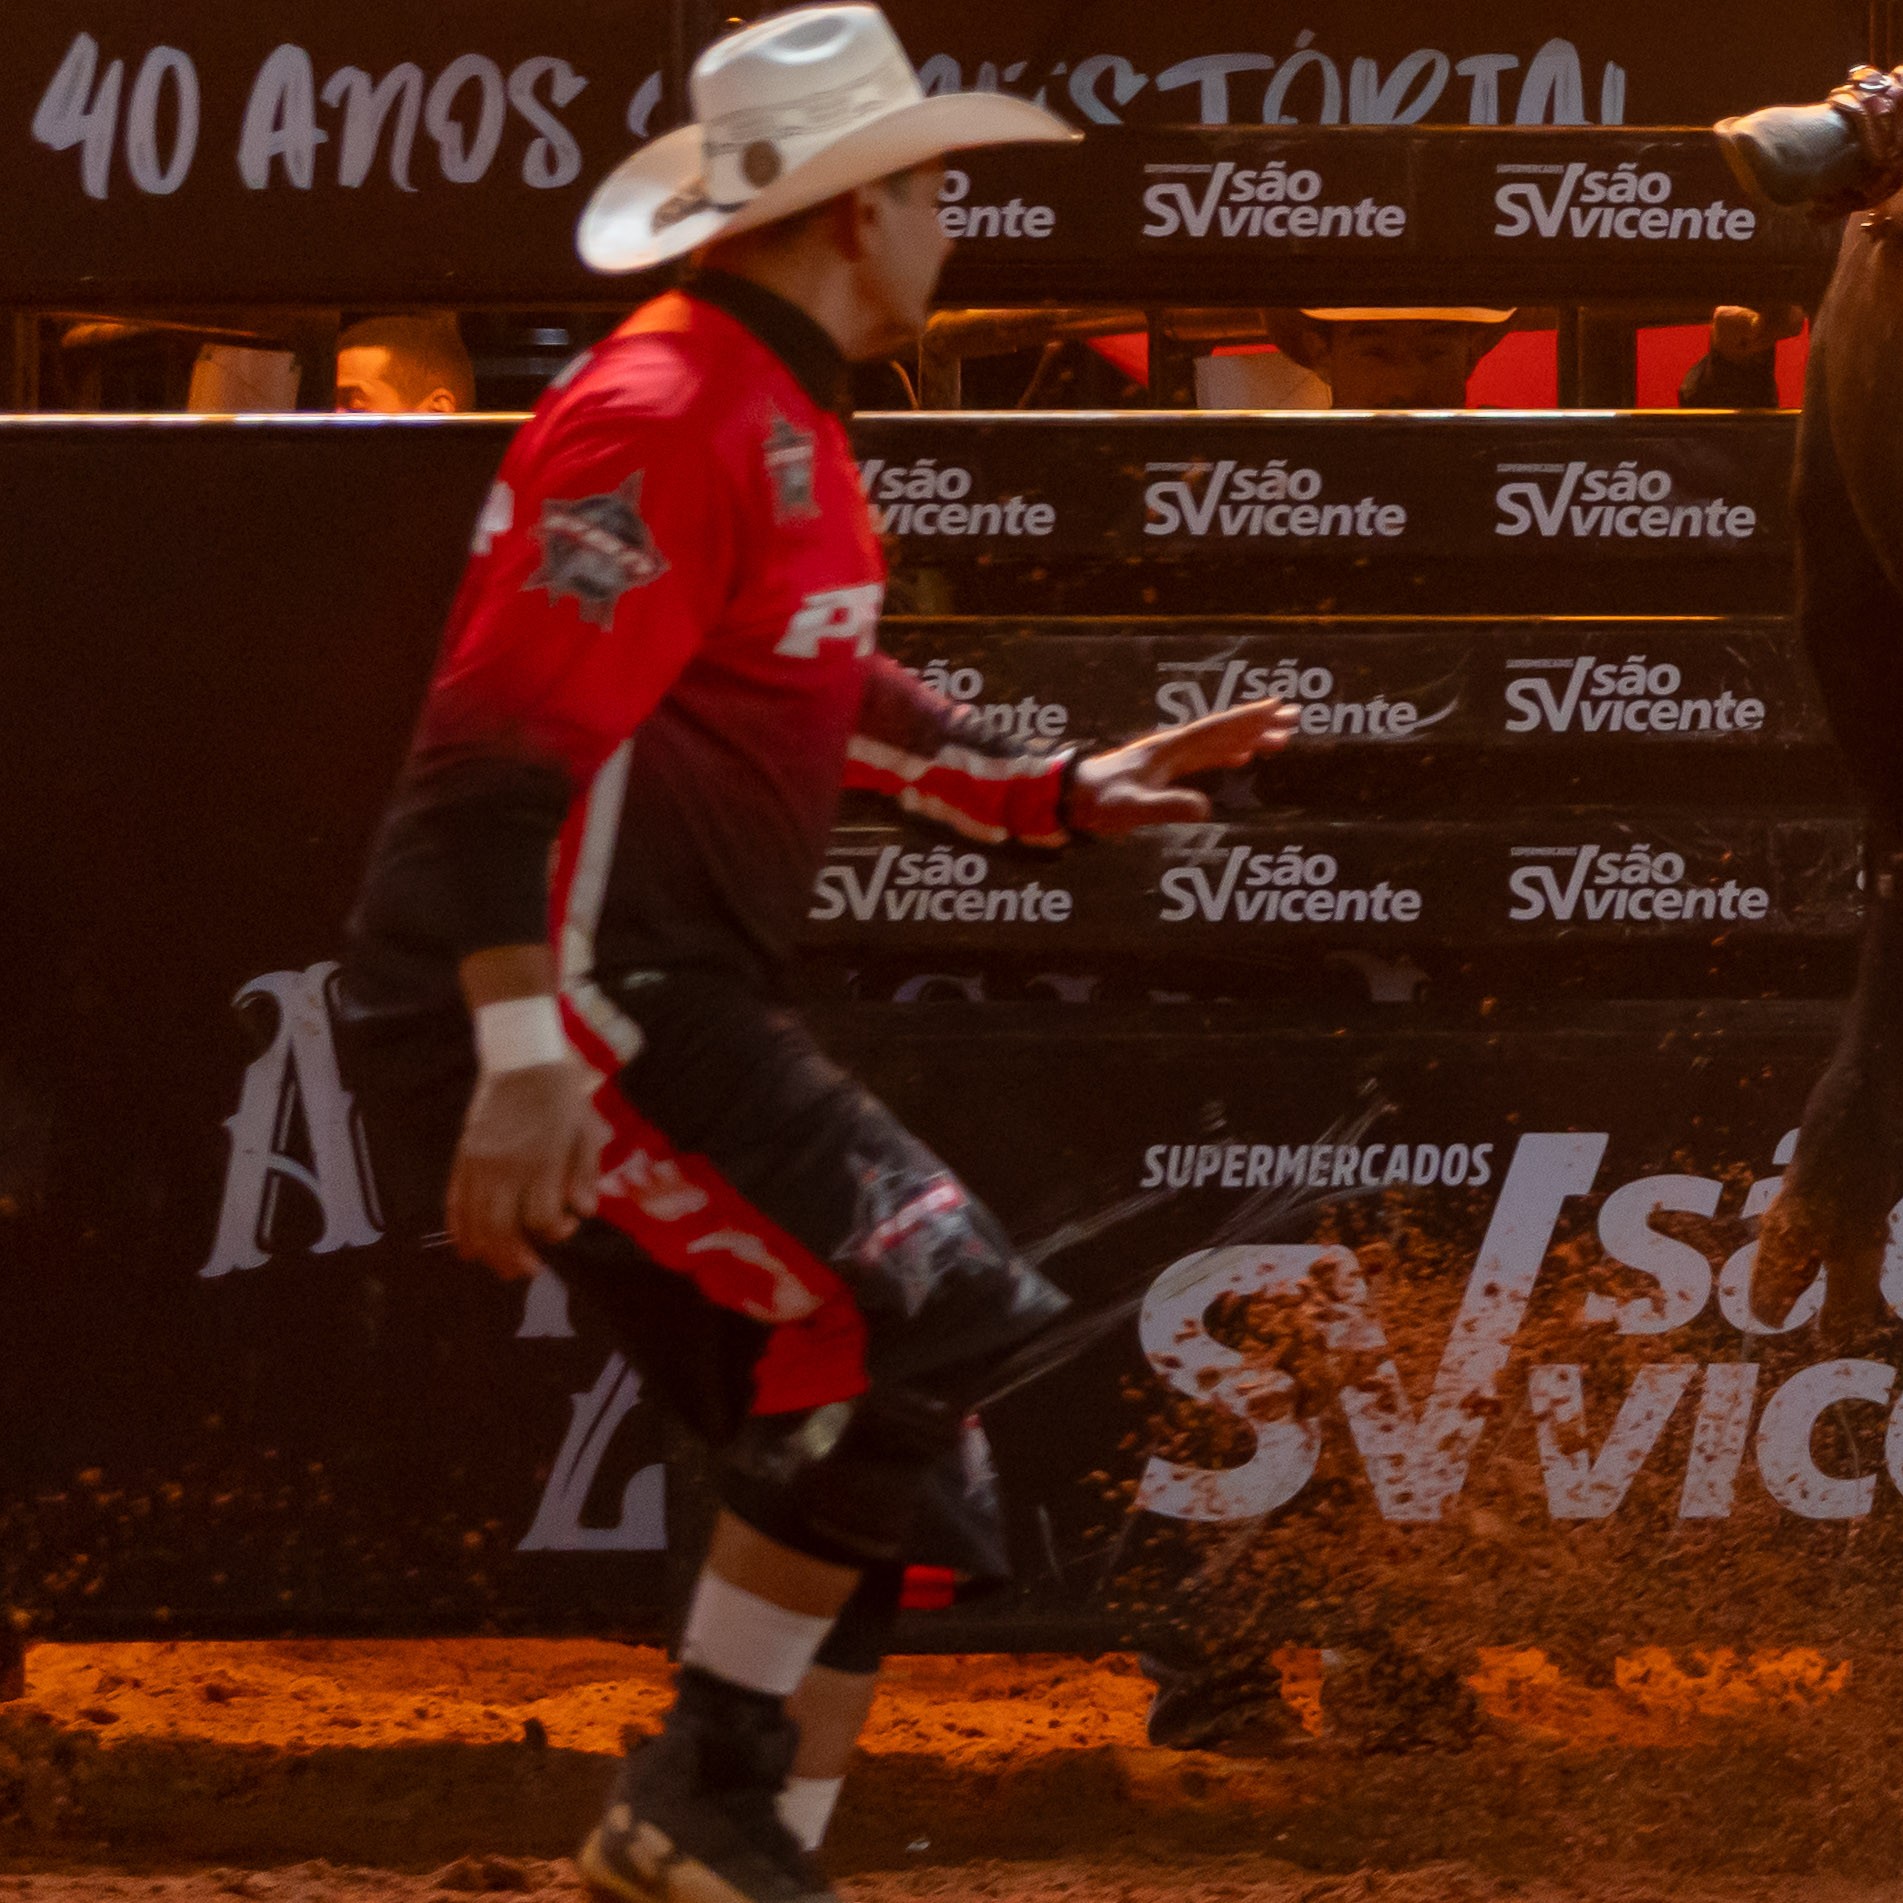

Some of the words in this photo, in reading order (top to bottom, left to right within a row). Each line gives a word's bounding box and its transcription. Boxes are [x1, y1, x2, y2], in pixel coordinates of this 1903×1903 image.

[31, 31, 200, 199] 40
[238, 43, 588, 192] ANOS
[1230, 163, 1322, 202] são
[1581, 163, 1672, 203] são
[936, 201, 1055, 238] ente
[1219, 195, 1407, 238] vicente
[1569, 196, 1756, 241] vicente
[879, 461, 971, 502] são
[1230, 461, 1322, 501] são
[1580, 462, 1673, 502] são
[1219, 494, 1407, 538] vicente
[1569, 495, 1757, 539] vicente
[908, 659, 985, 701] ão
[1586, 657, 1678, 699] são
[1297, 695, 1418, 736] ente
[1577, 689, 1766, 735] vicente
[893, 847, 988, 888] são
[1244, 847, 1339, 887] são
[1591, 845, 1686, 887] são
[883, 876, 1074, 923] vicente
[1234, 876, 1423, 922] vicente
[1581, 876, 1769, 922] vicente
[1140, 1141, 1494, 1190] SUPERMERCADOS
